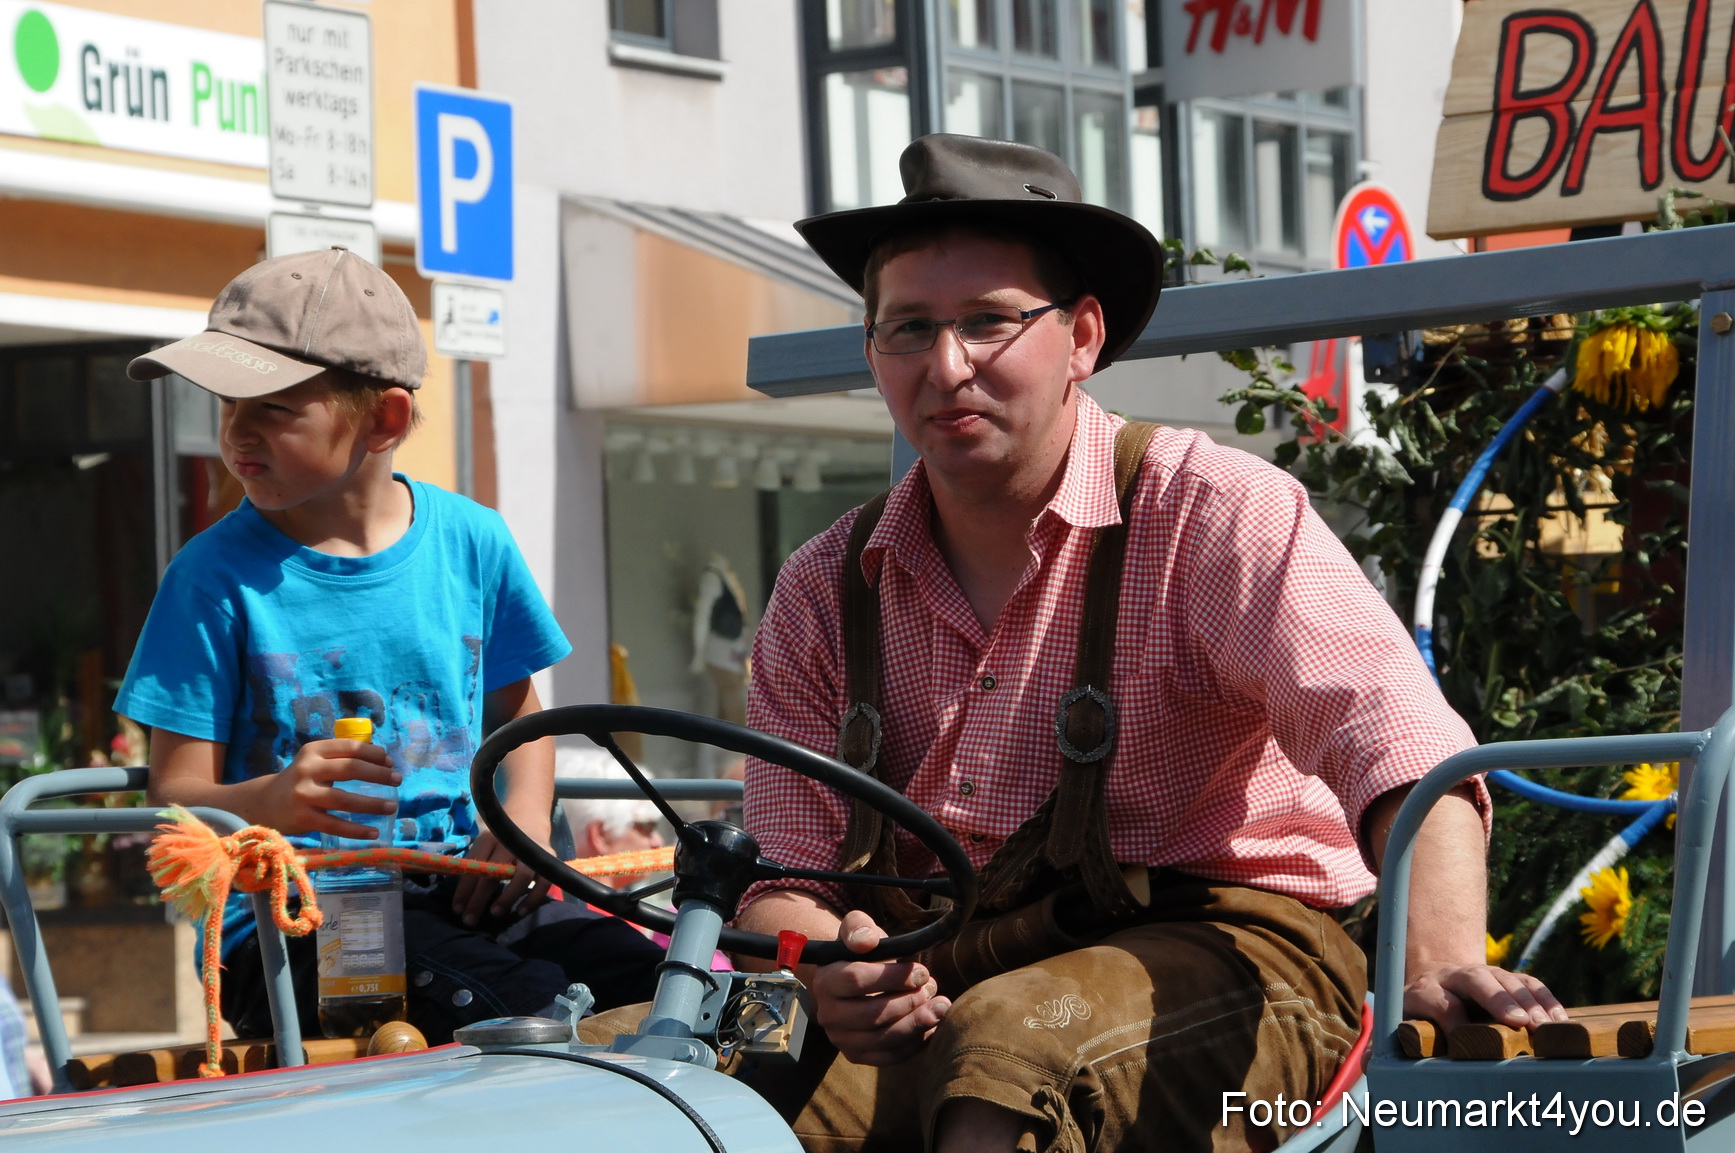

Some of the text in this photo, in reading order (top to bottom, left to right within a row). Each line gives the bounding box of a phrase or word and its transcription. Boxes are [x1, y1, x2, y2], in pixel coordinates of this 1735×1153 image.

[287, 23, 349, 48] nur mit
[1183, 0, 1322, 54] H&M
[80, 43, 169, 122] Grün
[274, 47, 363, 83] Parkschein
[283, 88, 358, 119] werktags
[437, 112, 494, 254] P
